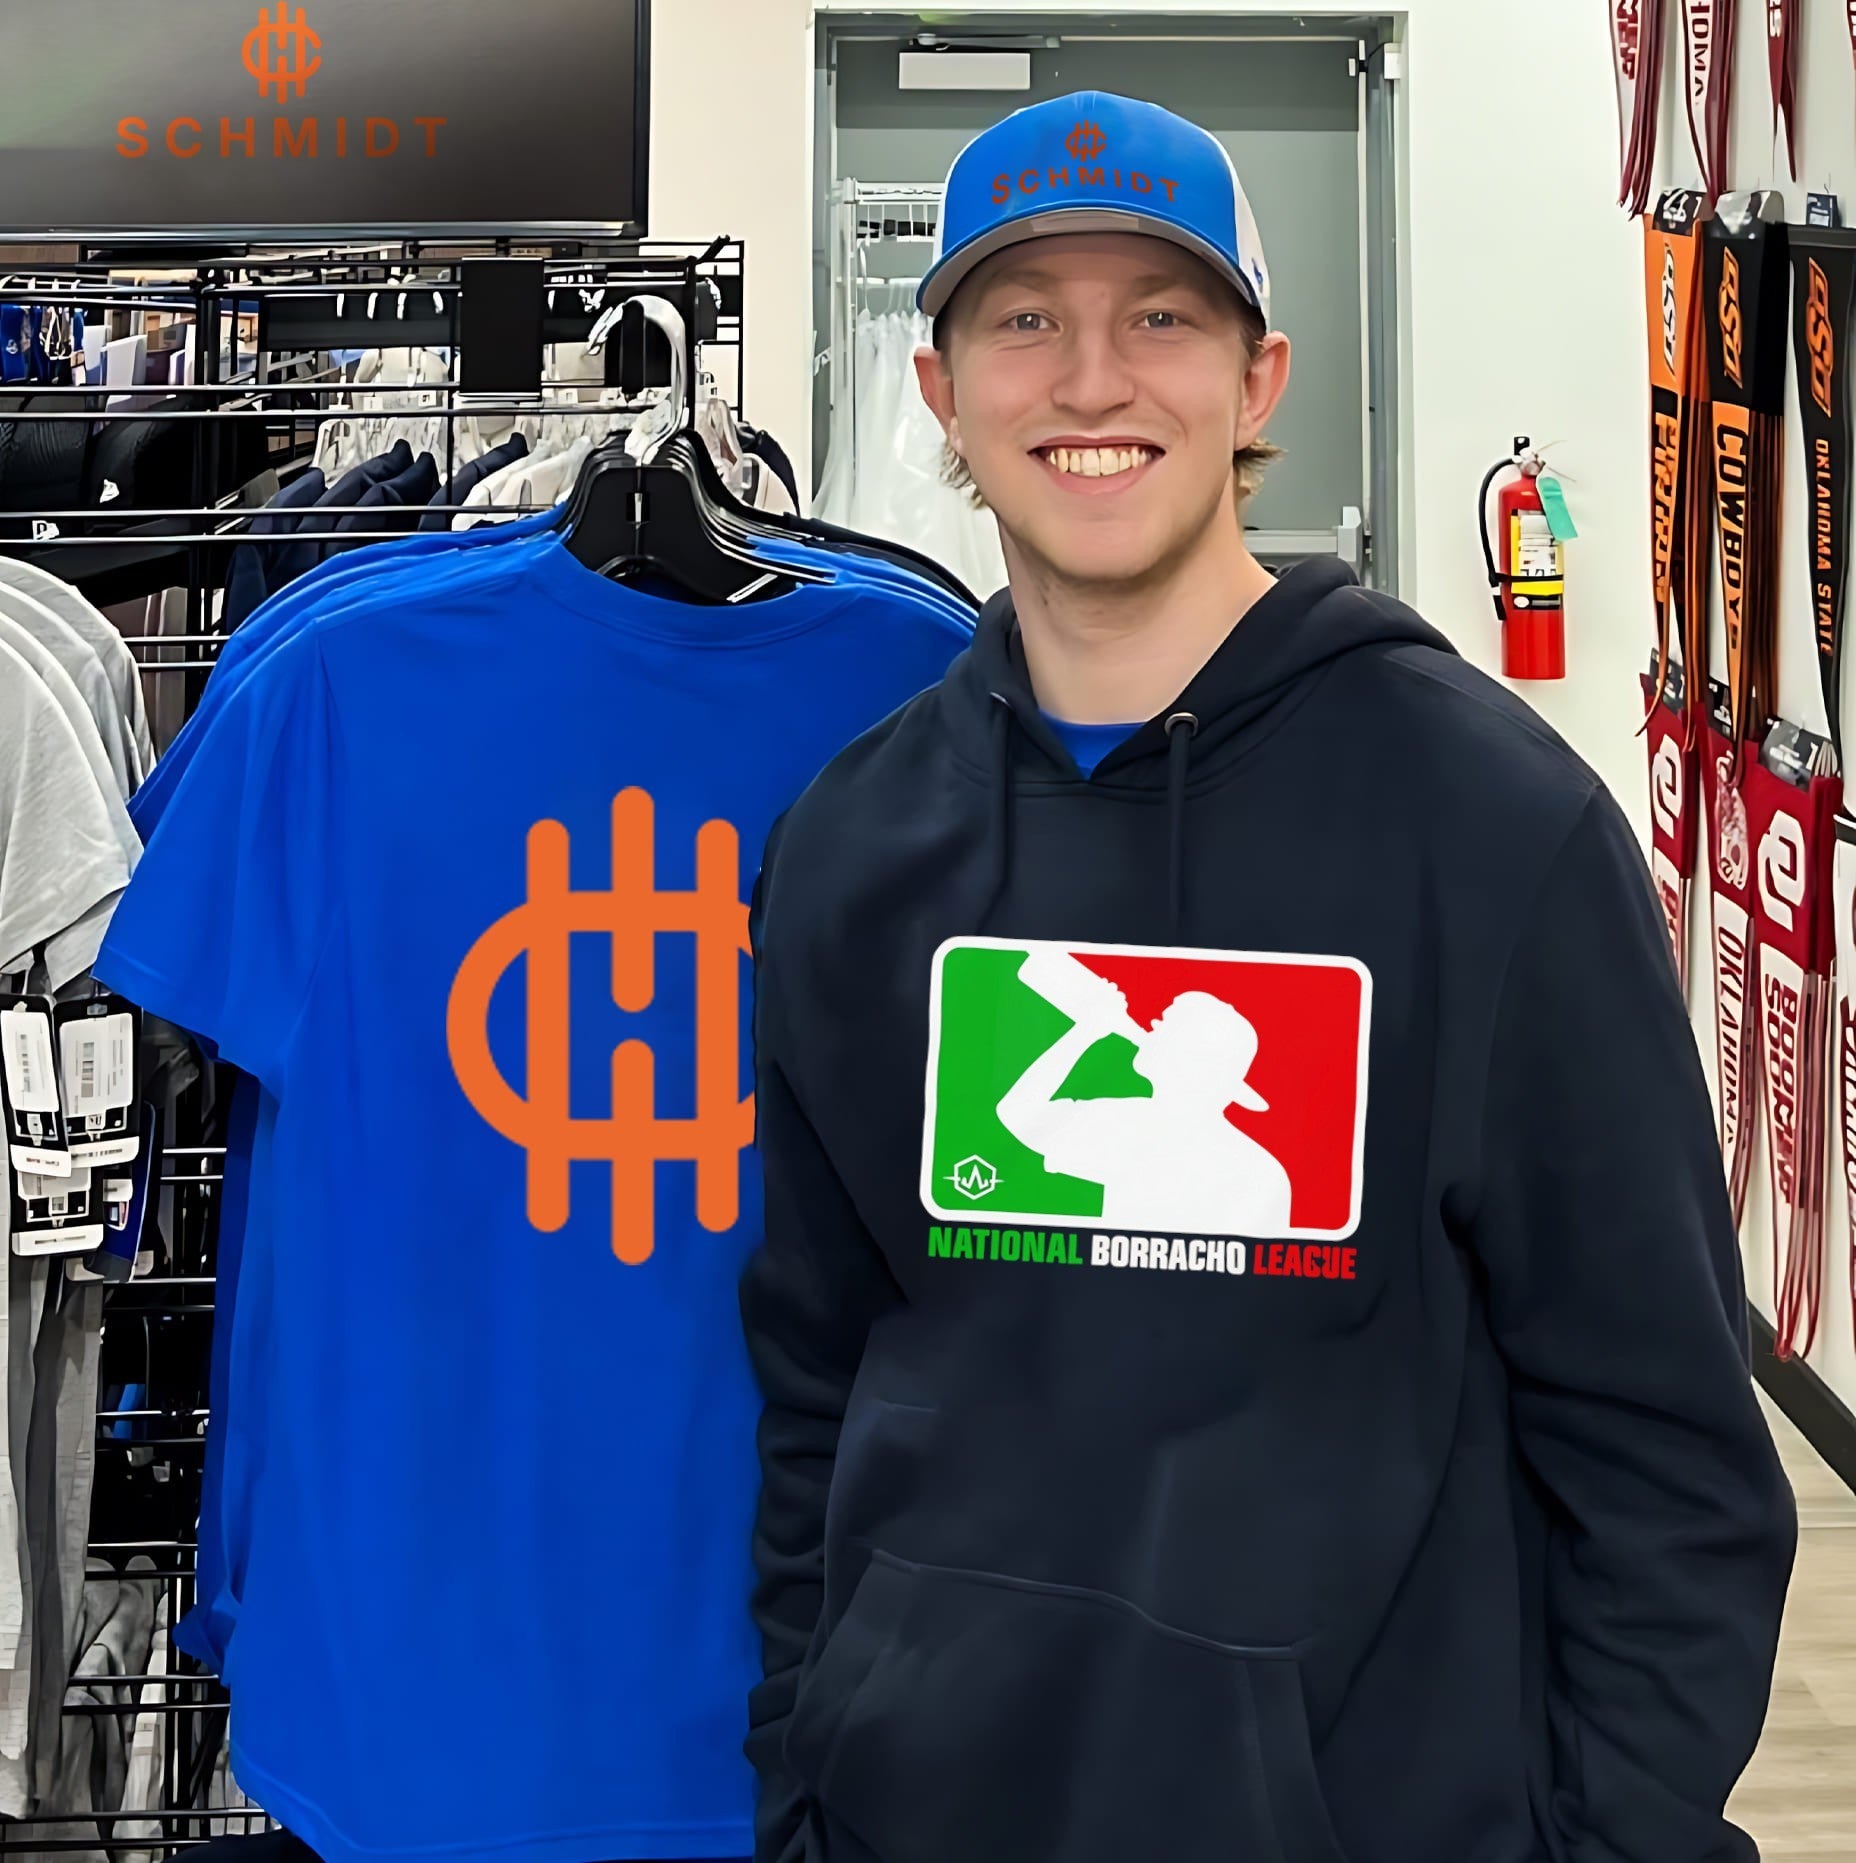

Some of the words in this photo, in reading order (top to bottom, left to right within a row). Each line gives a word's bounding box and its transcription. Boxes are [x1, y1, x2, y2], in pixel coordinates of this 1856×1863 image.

[115, 116, 448, 159] SCHMIDT
[991, 166, 1179, 205] SCHMIDT
[1815, 438, 1832, 571] OKLAHOMA
[1718, 926, 1746, 1144] OKLAHOMA
[928, 1226, 1083, 1265] NATIONAL
[1091, 1234, 1246, 1275] BORRACHO
[1253, 1244, 1358, 1280] LEAGUE
